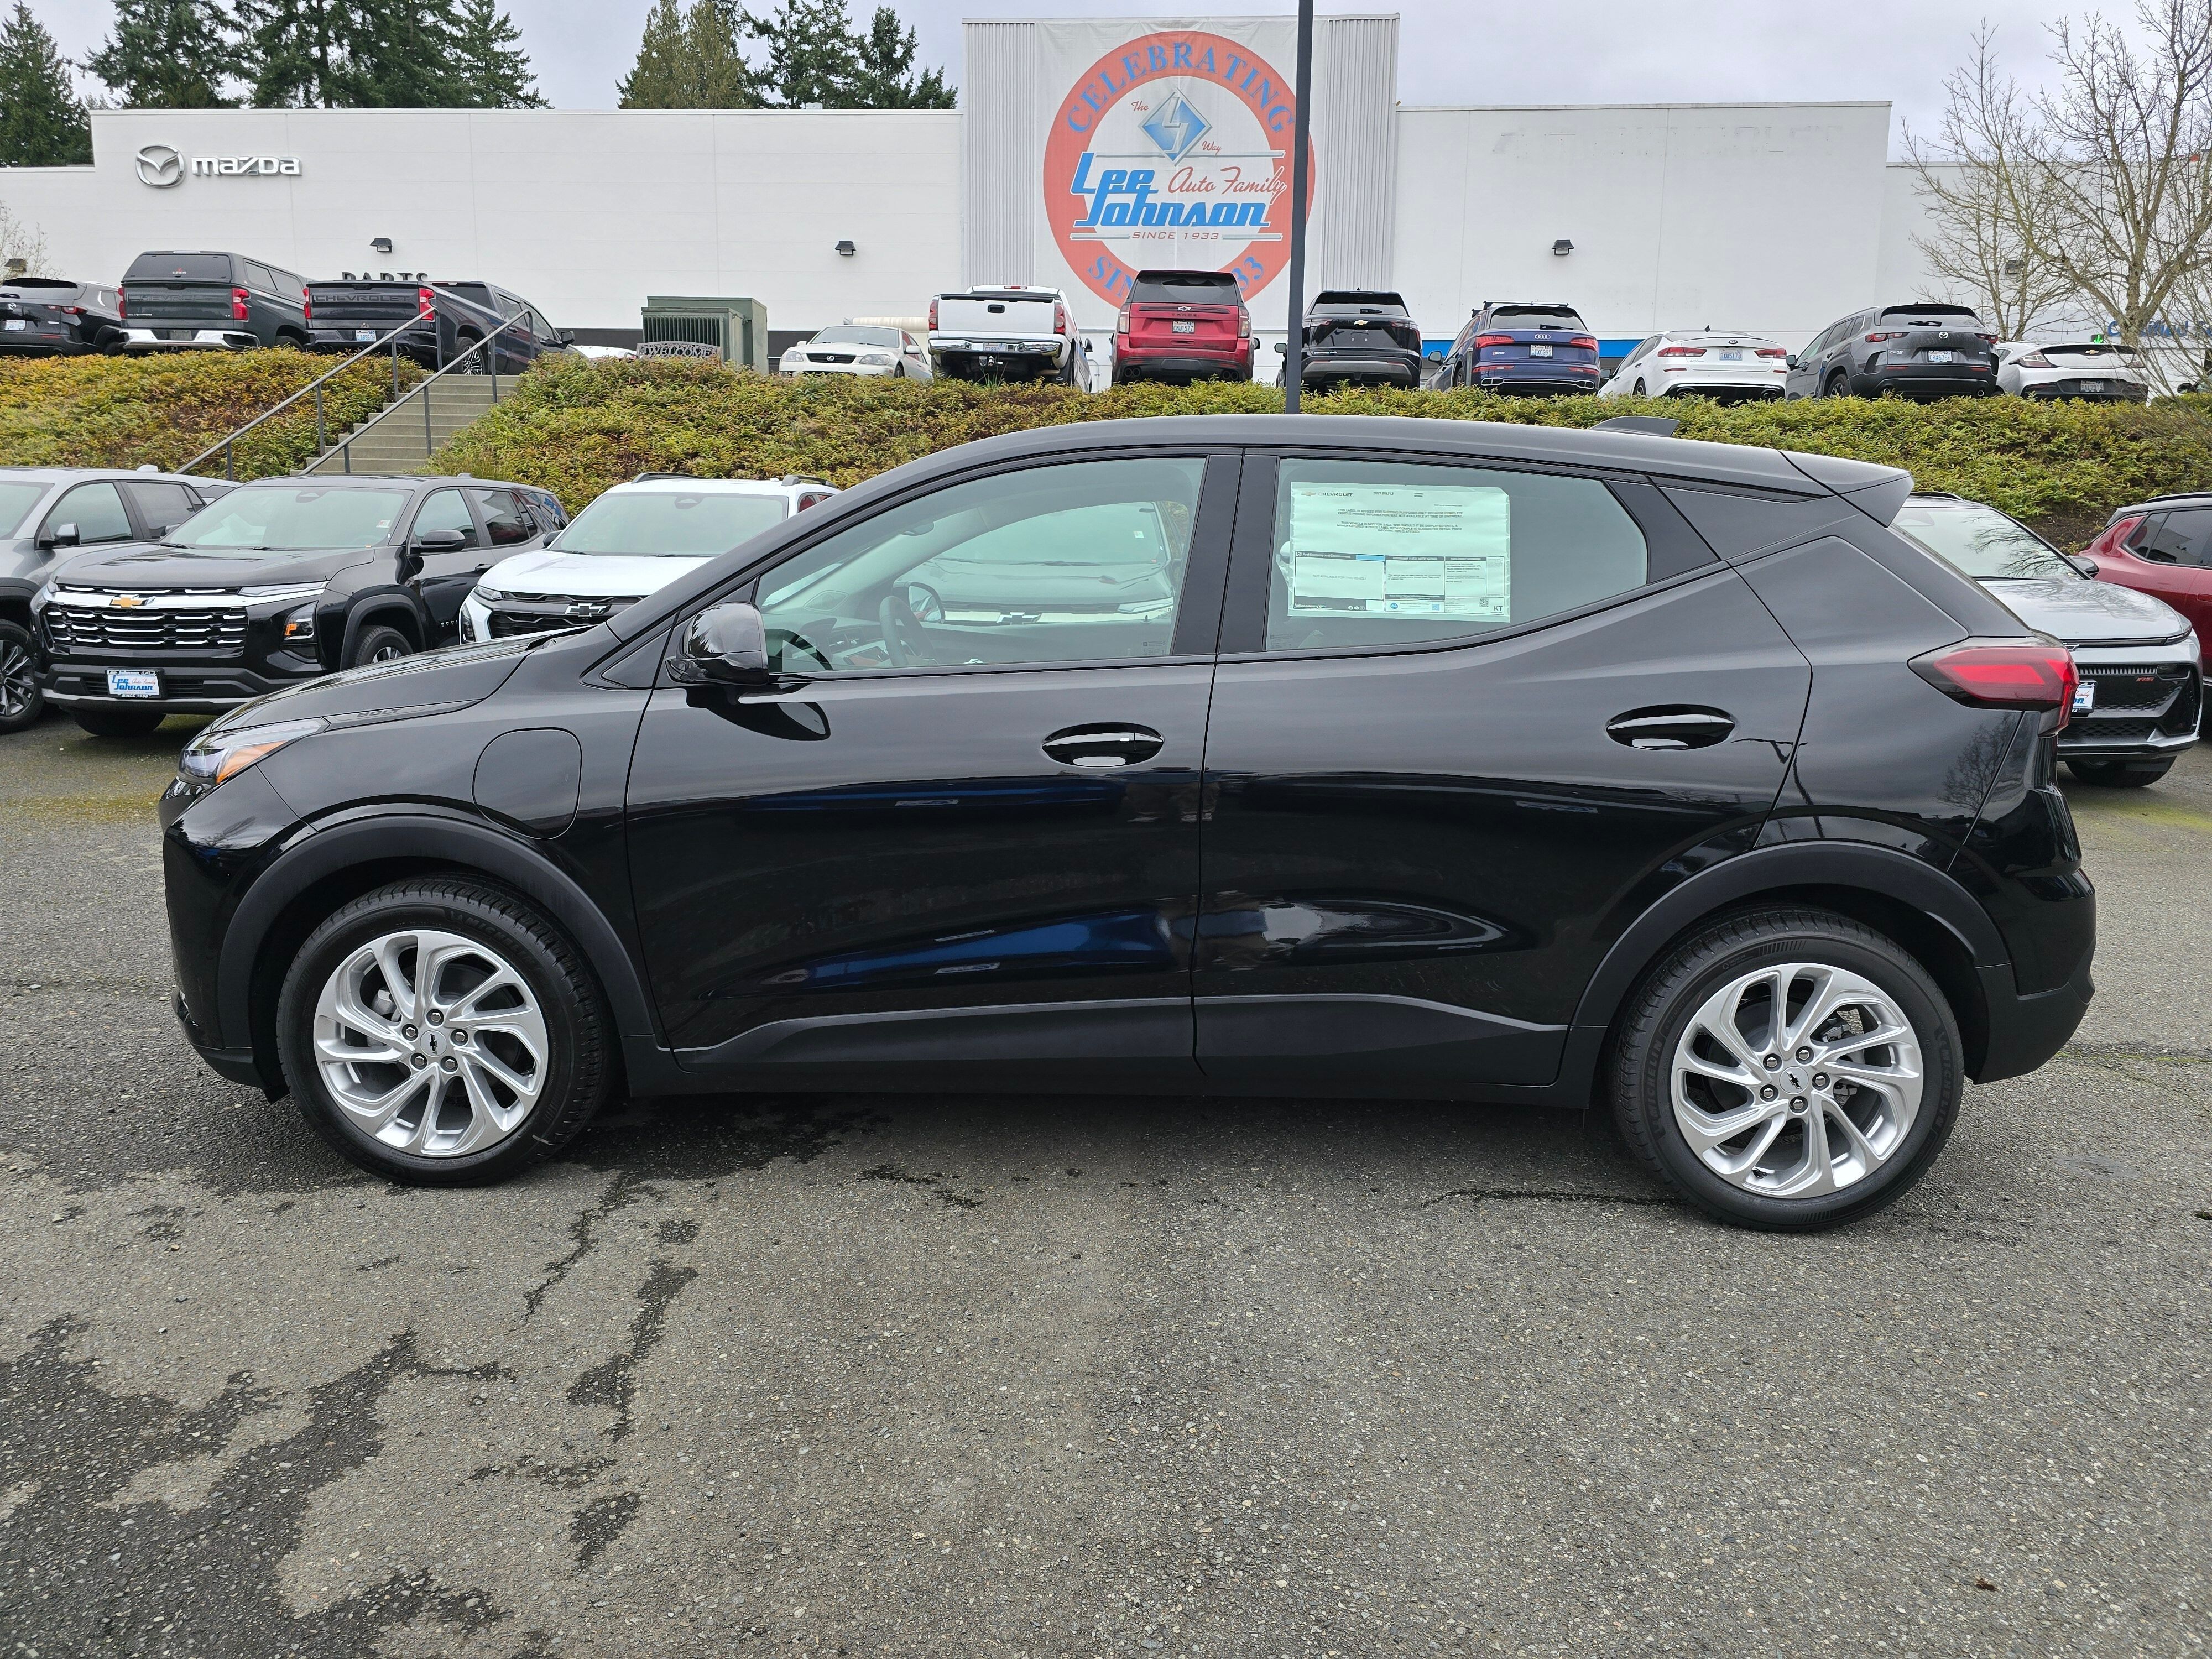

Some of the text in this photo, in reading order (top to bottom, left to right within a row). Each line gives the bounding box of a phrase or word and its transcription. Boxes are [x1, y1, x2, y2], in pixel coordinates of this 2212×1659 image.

[1067, 42, 1295, 133] CELEBRATING
[1131, 100, 1149, 112] The
[1202, 140, 1222, 155] Way
[191, 156, 302, 176] mazda
[1071, 152, 1159, 194] Lee
[1168, 166, 1286, 205] Auto Family
[1074, 187, 1271, 227] Johnson
[1131, 231, 1219, 241] SINCE 1933
[1087, 255, 1134, 298] SIN
[648, 346, 711, 358] WELCOME
[112, 675, 129, 684] Lee
[114, 682, 154, 690] Johnson
[357, 708, 401, 717] BOLT
